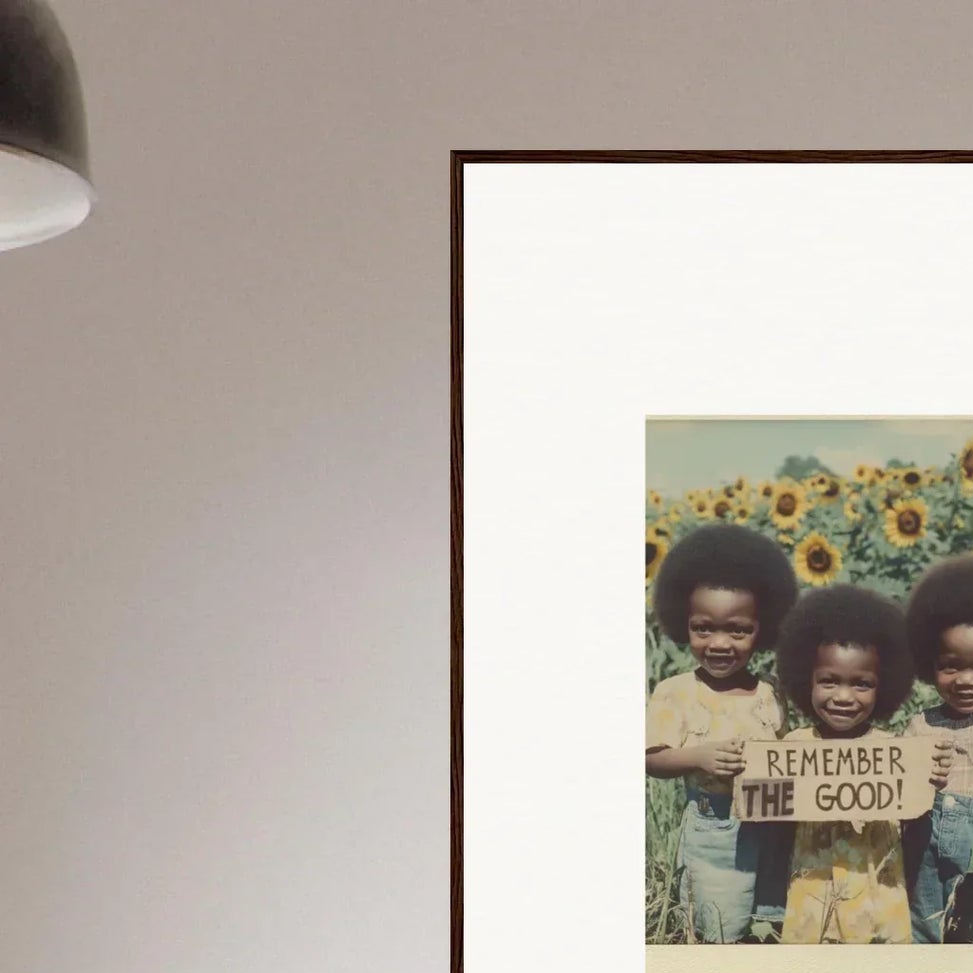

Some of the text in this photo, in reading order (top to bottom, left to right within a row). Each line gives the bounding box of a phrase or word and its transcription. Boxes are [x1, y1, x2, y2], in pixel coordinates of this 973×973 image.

[766, 746, 906, 777] REMEMBER
[742, 779, 904, 818] THE GOOD!
